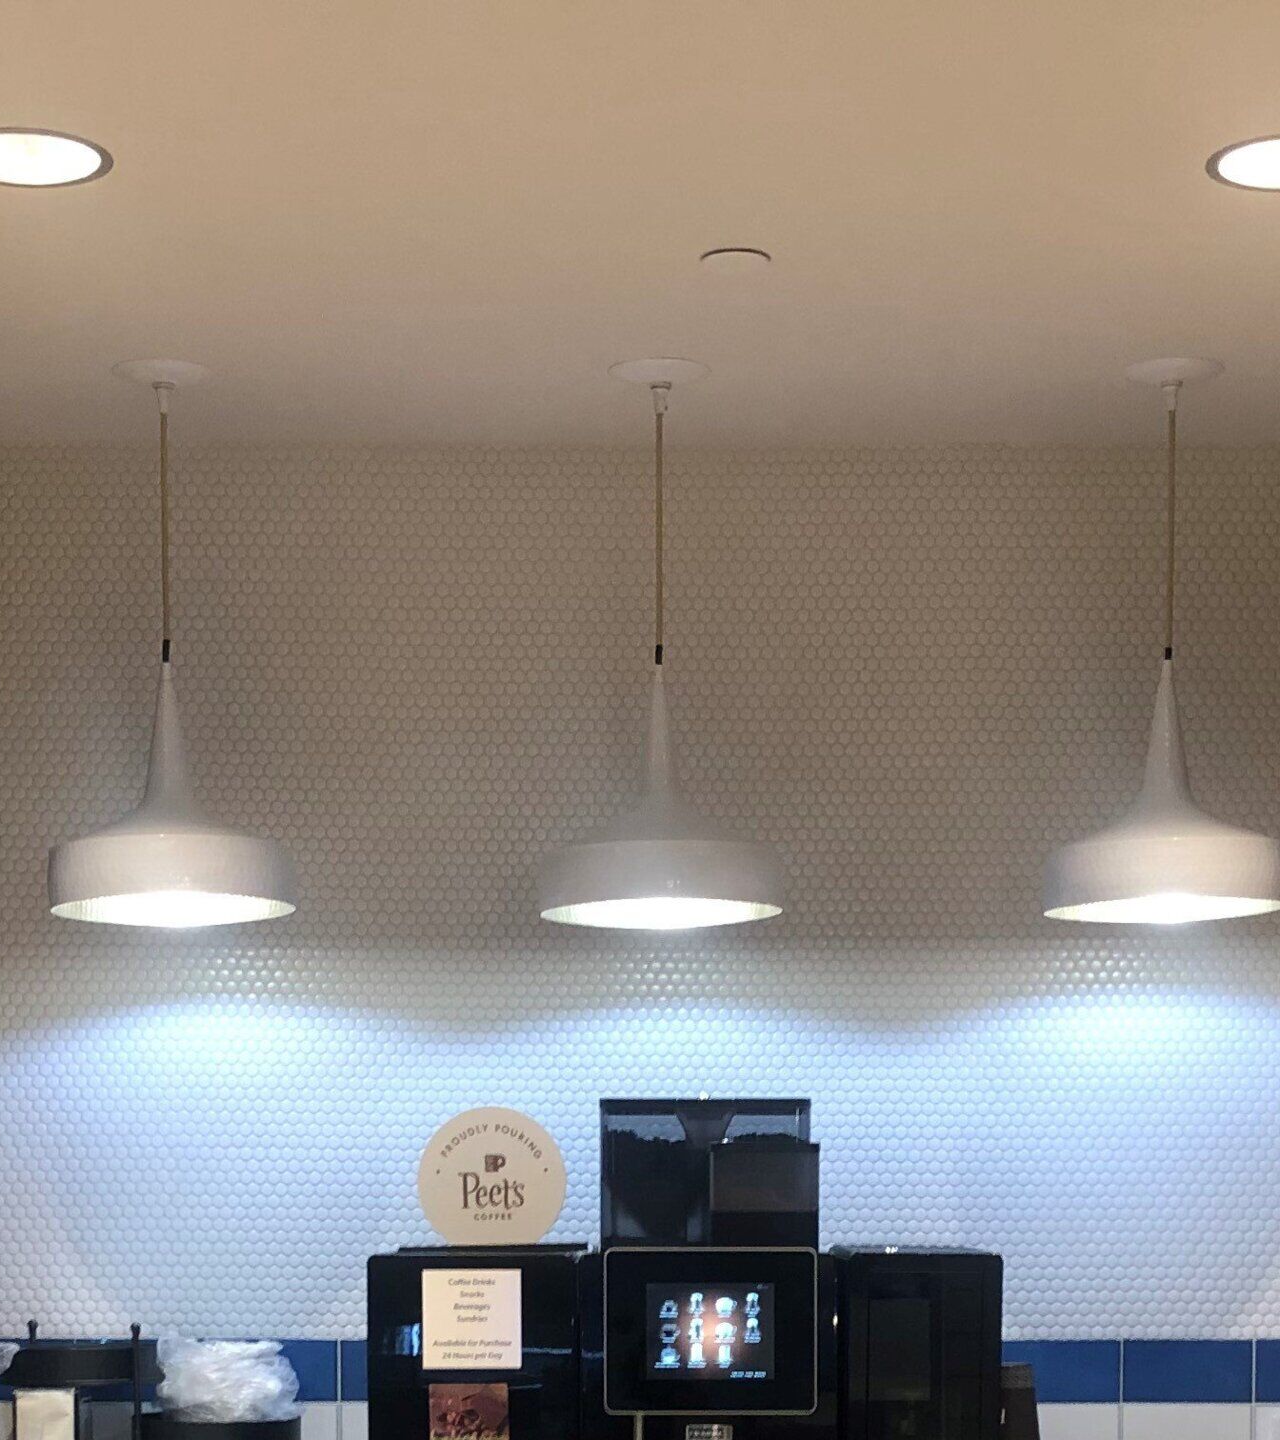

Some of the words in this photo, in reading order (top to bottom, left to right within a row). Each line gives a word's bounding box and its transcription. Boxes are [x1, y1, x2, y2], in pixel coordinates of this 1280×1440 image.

[440, 1123, 488, 1158] PROUDLY
[494, 1124, 543, 1159] POURING
[458, 1171, 525, 1210] Peet's
[473, 1213, 512, 1221] COFFEE
